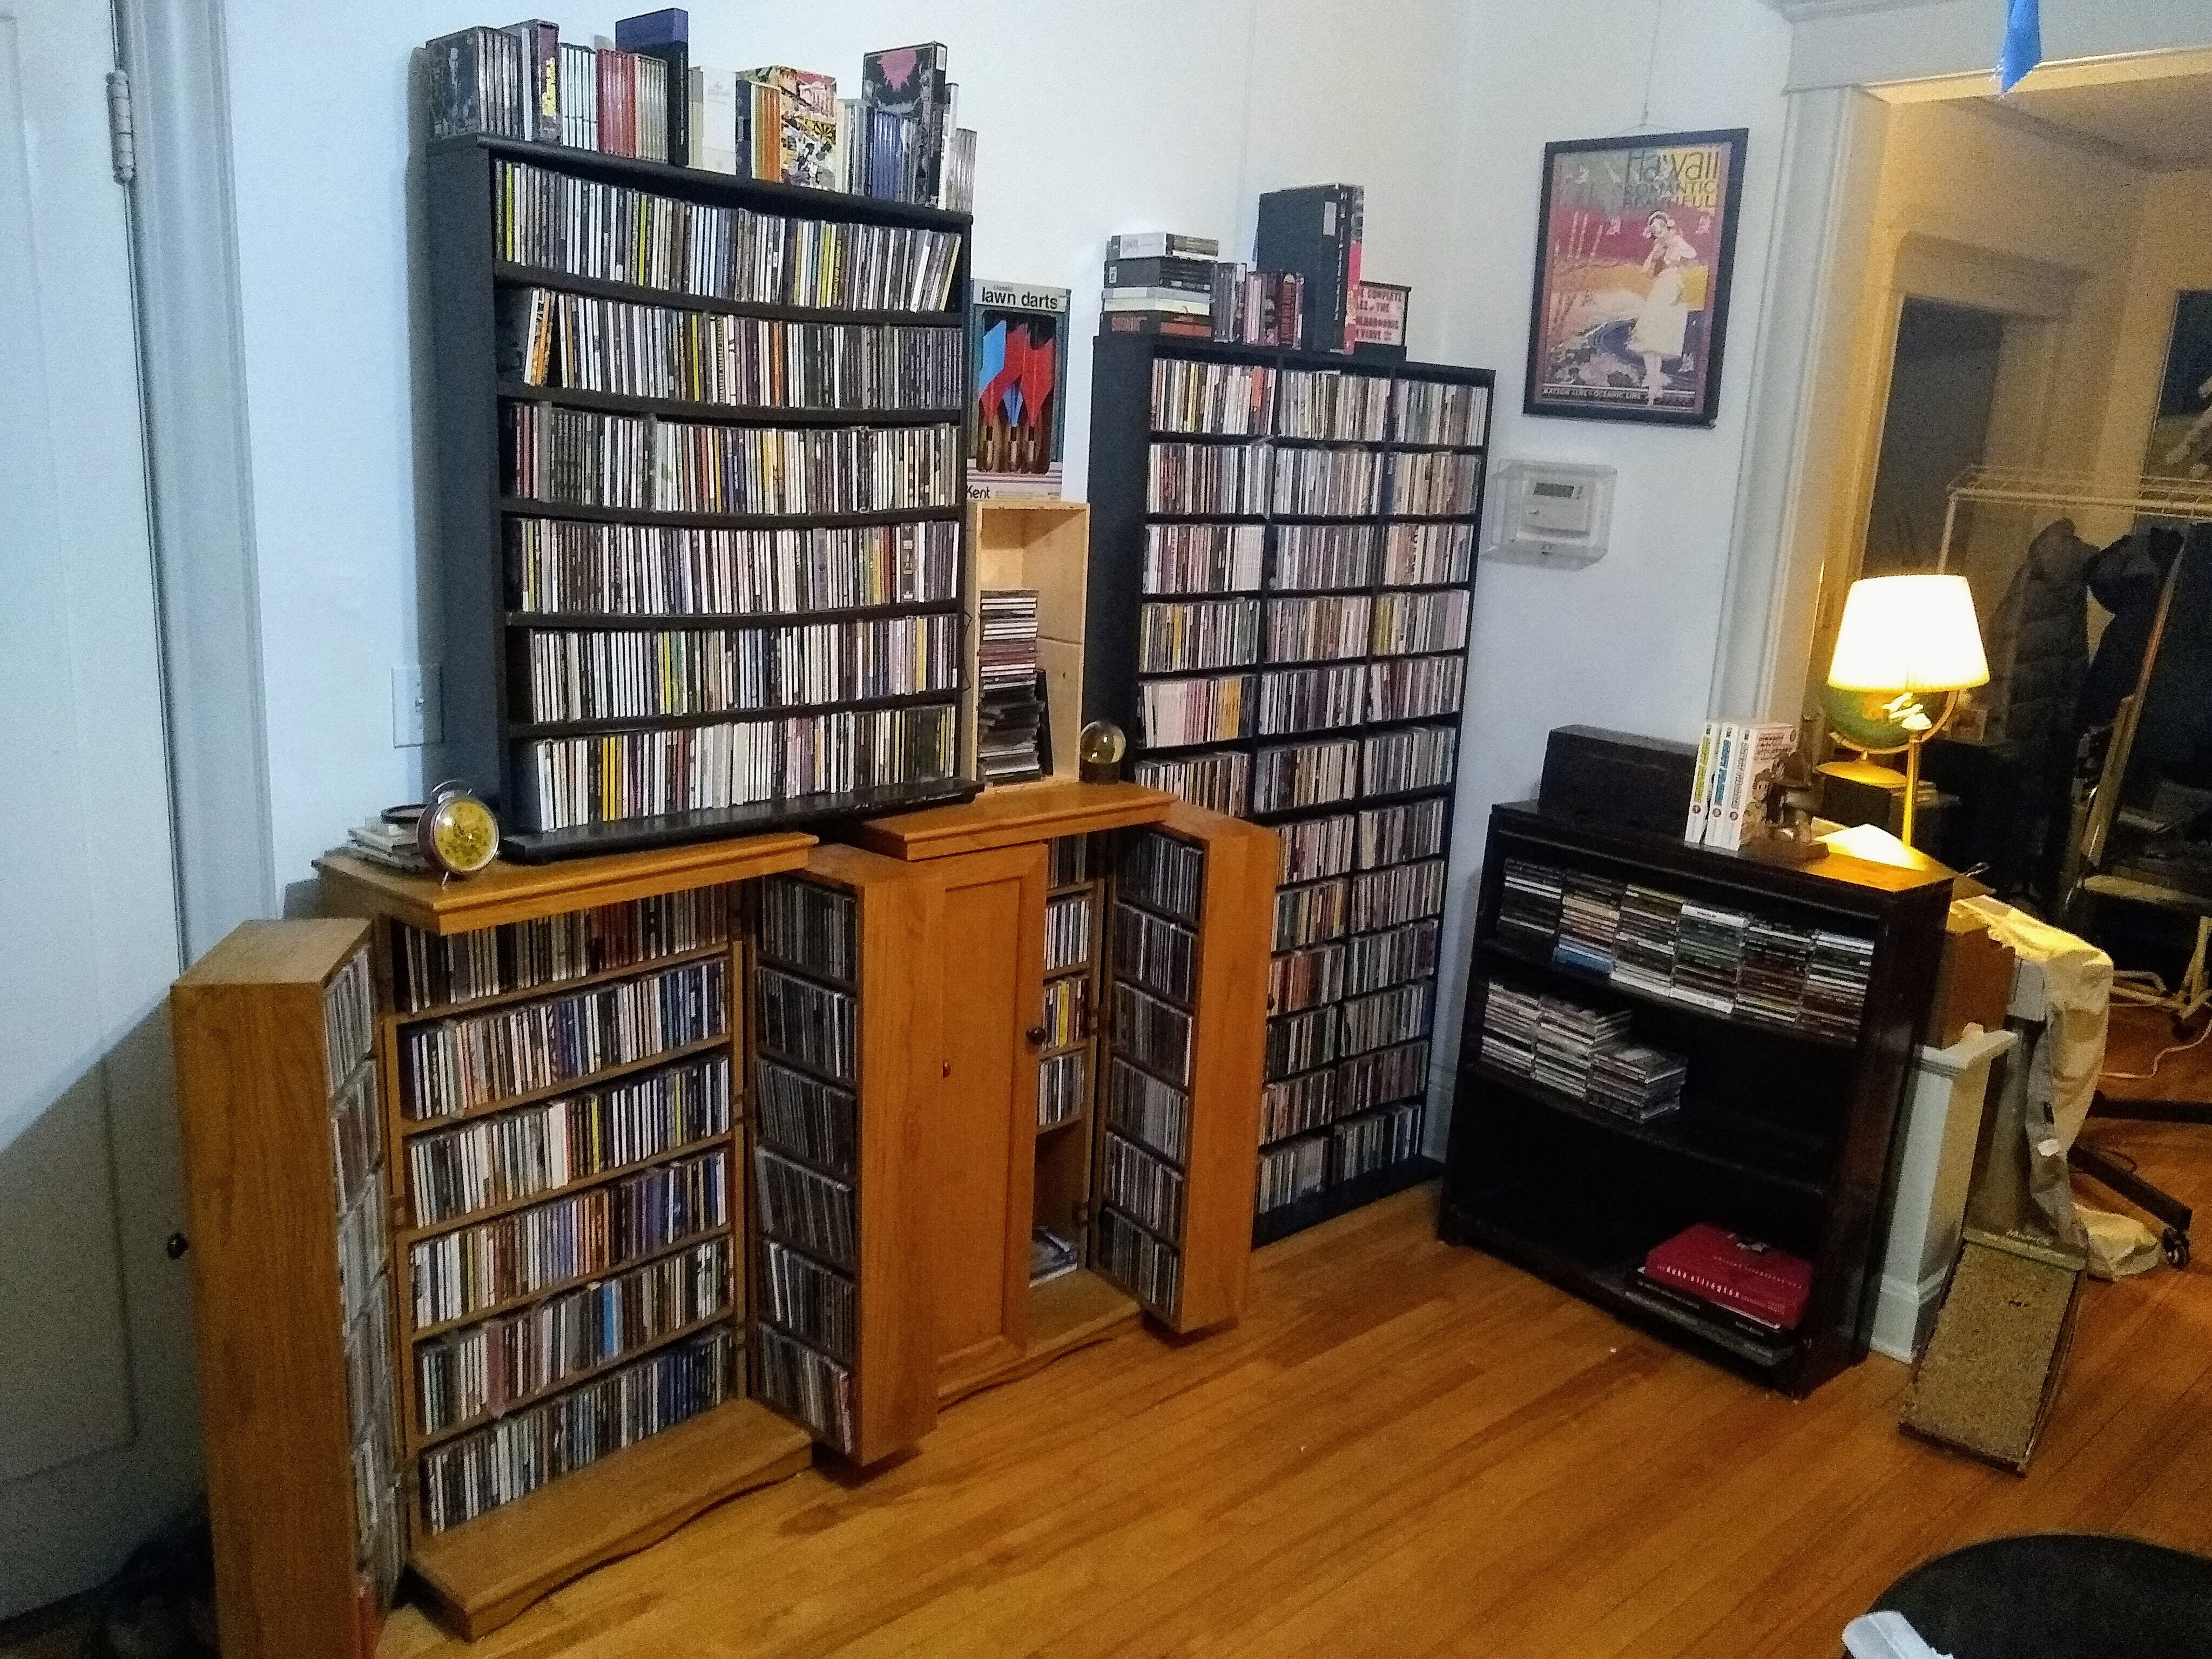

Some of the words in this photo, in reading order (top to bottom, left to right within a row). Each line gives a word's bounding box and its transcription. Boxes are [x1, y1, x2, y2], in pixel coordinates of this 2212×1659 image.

[981, 286, 1016, 305] lawn
[1021, 292, 1058, 309] darts
[967, 485, 990, 499] Kent
